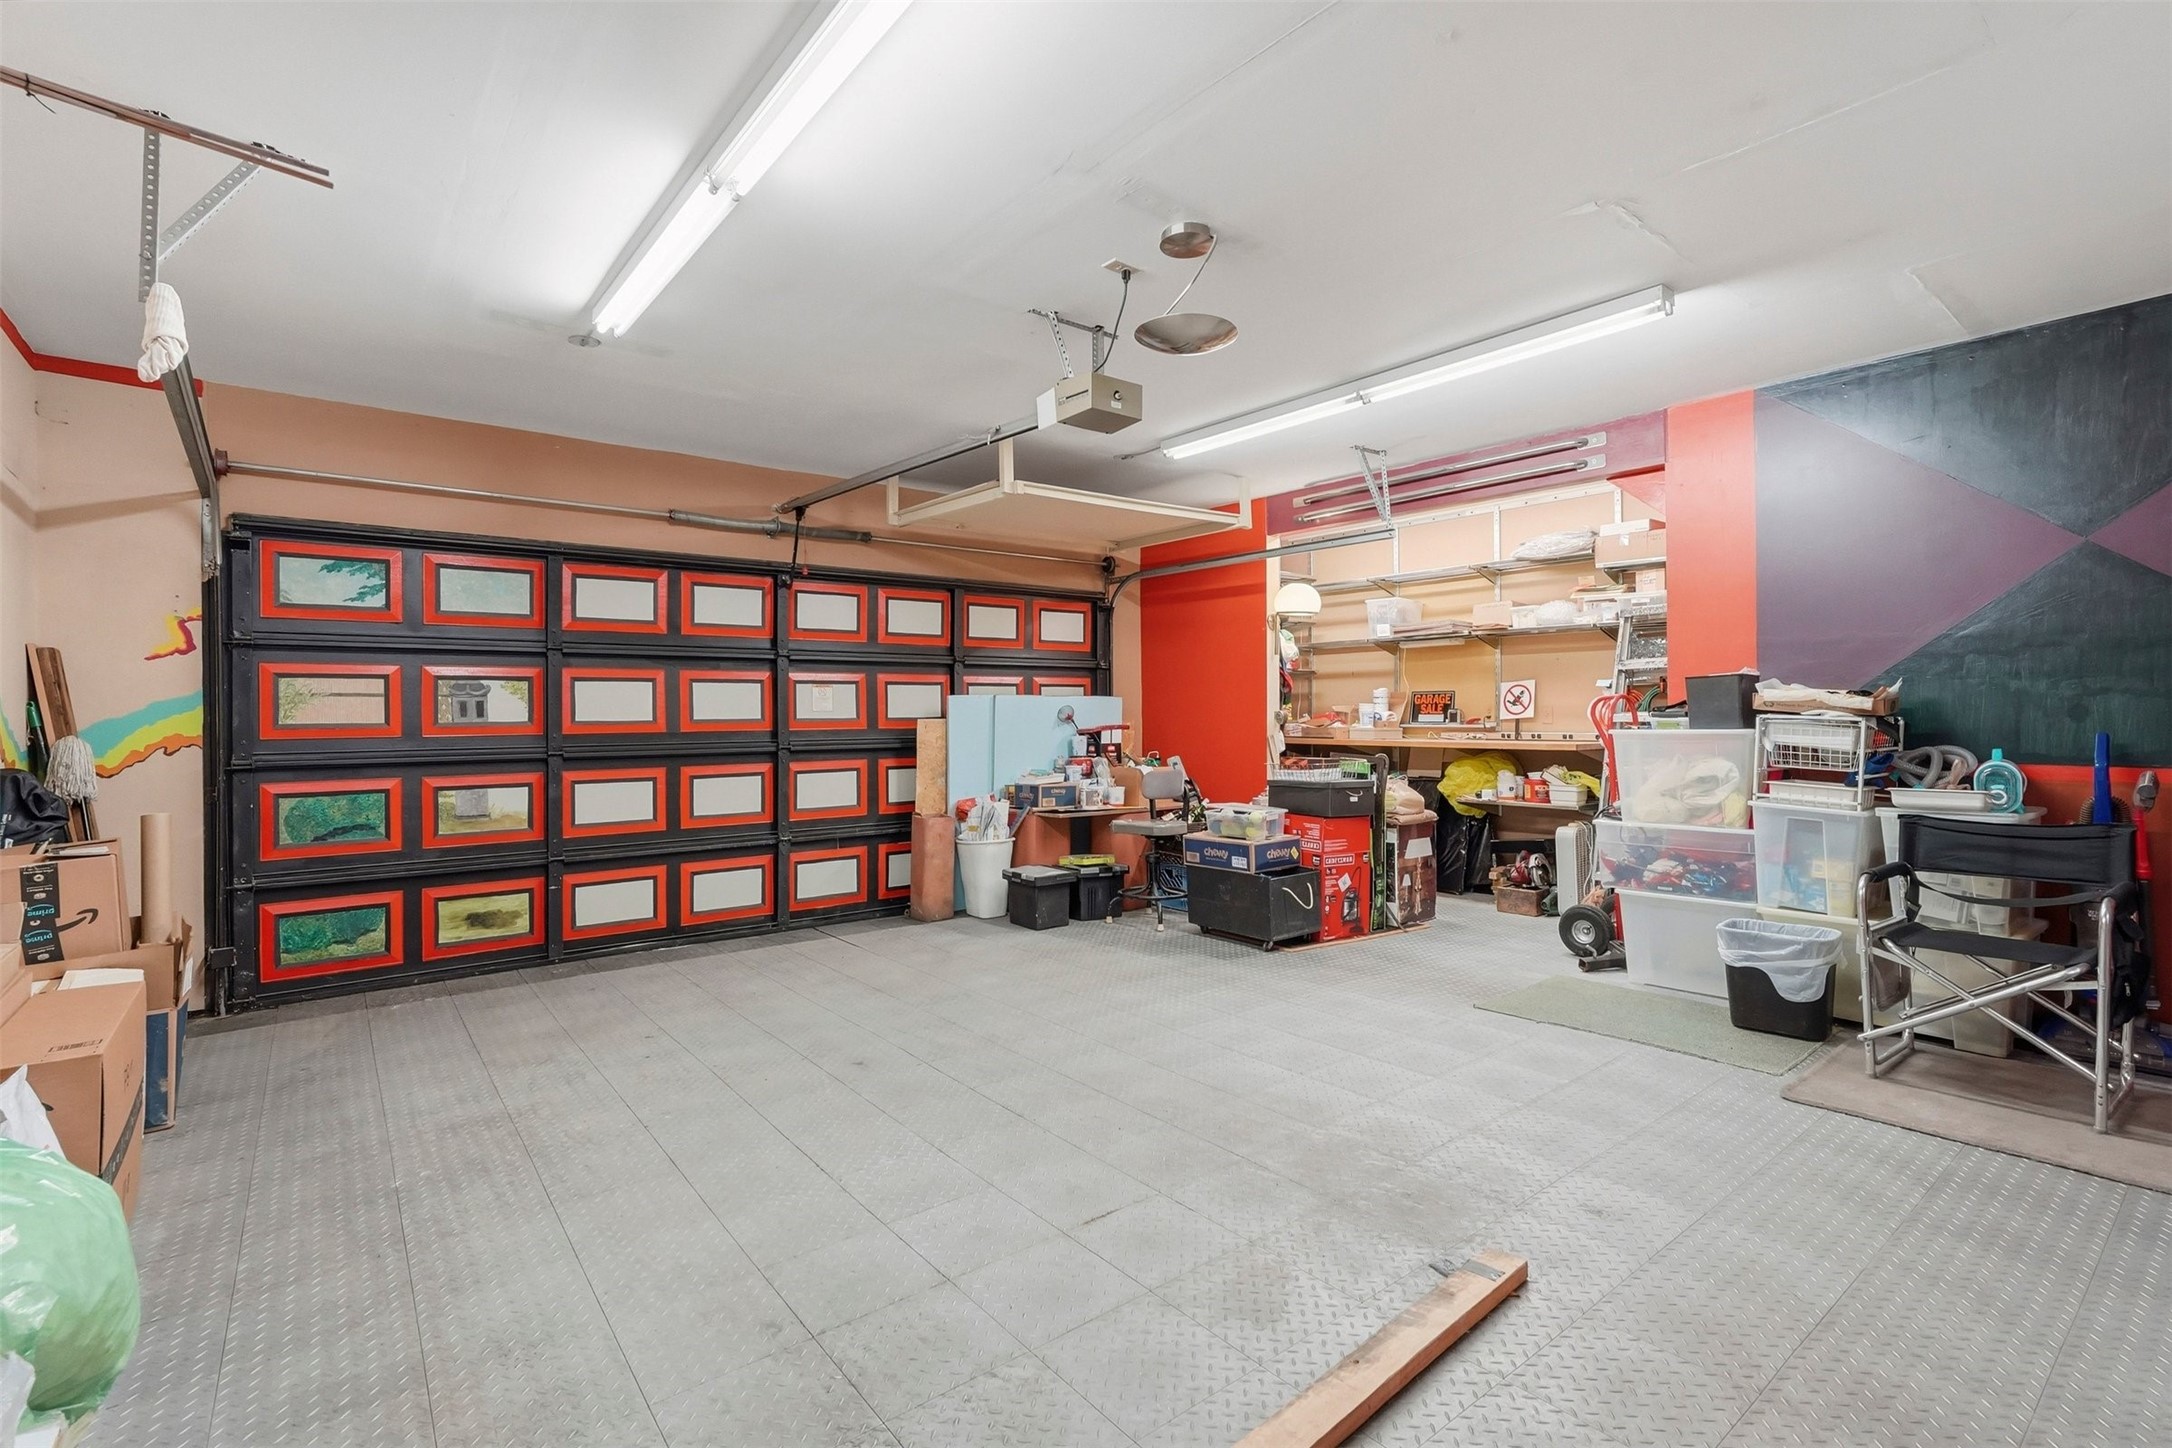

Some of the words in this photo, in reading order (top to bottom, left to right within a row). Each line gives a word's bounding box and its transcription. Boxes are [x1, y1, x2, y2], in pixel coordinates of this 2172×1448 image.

[1415, 694, 1451, 704] GARAGE
[1420, 704, 1443, 714] SALE
[1204, 847, 1228, 859] chewy
[1267, 848, 1290, 859] chewy
[27, 907, 55, 916] prime
[26, 932, 53, 943] prime
